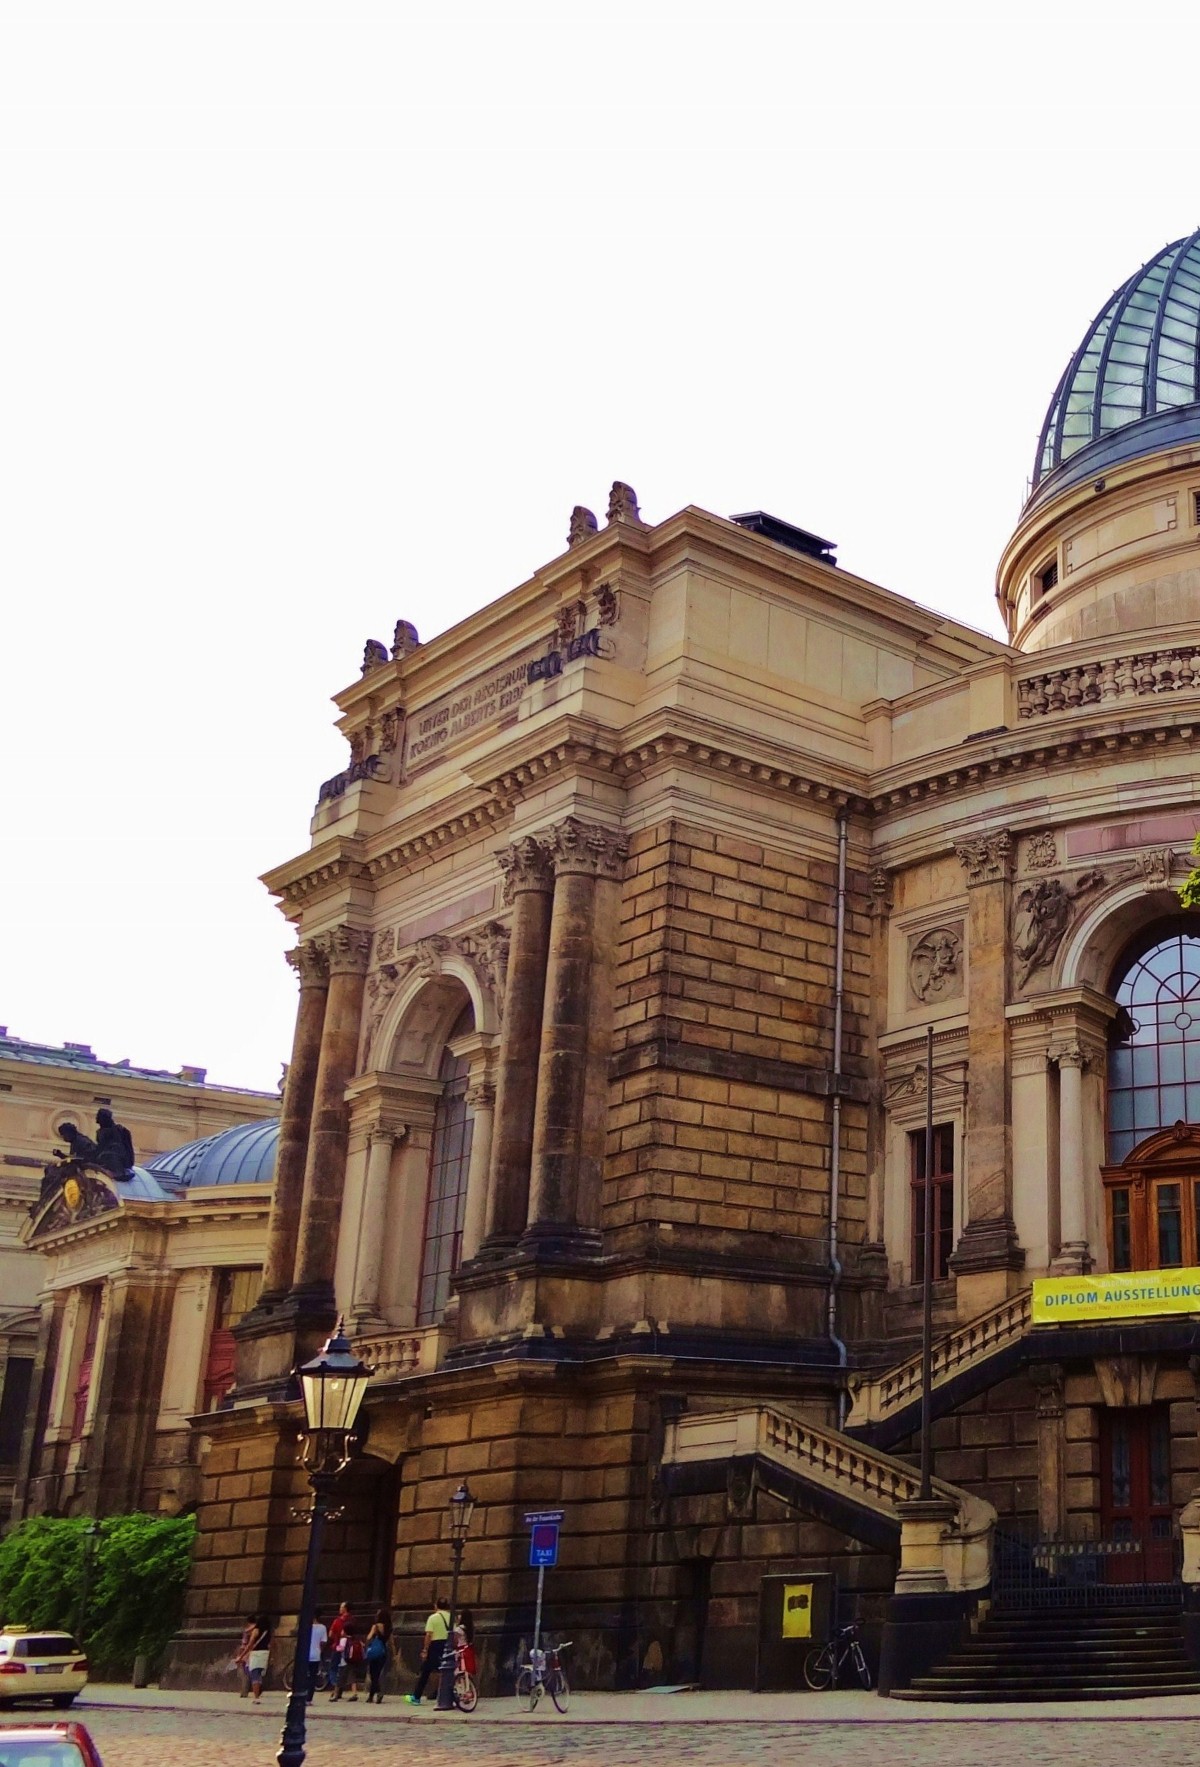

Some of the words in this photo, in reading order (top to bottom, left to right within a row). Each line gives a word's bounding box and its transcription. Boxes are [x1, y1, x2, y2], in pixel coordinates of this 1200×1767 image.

[410, 727, 448, 759] KOENIG
[450, 699, 496, 737] ALBERTS
[499, 682, 527, 710] ERBA
[419, 708, 449, 736] UNTER
[450, 695, 472, 718] DER
[474, 663, 528, 706] REGIERUN
[1045, 1292, 1098, 1307] DIPLOM
